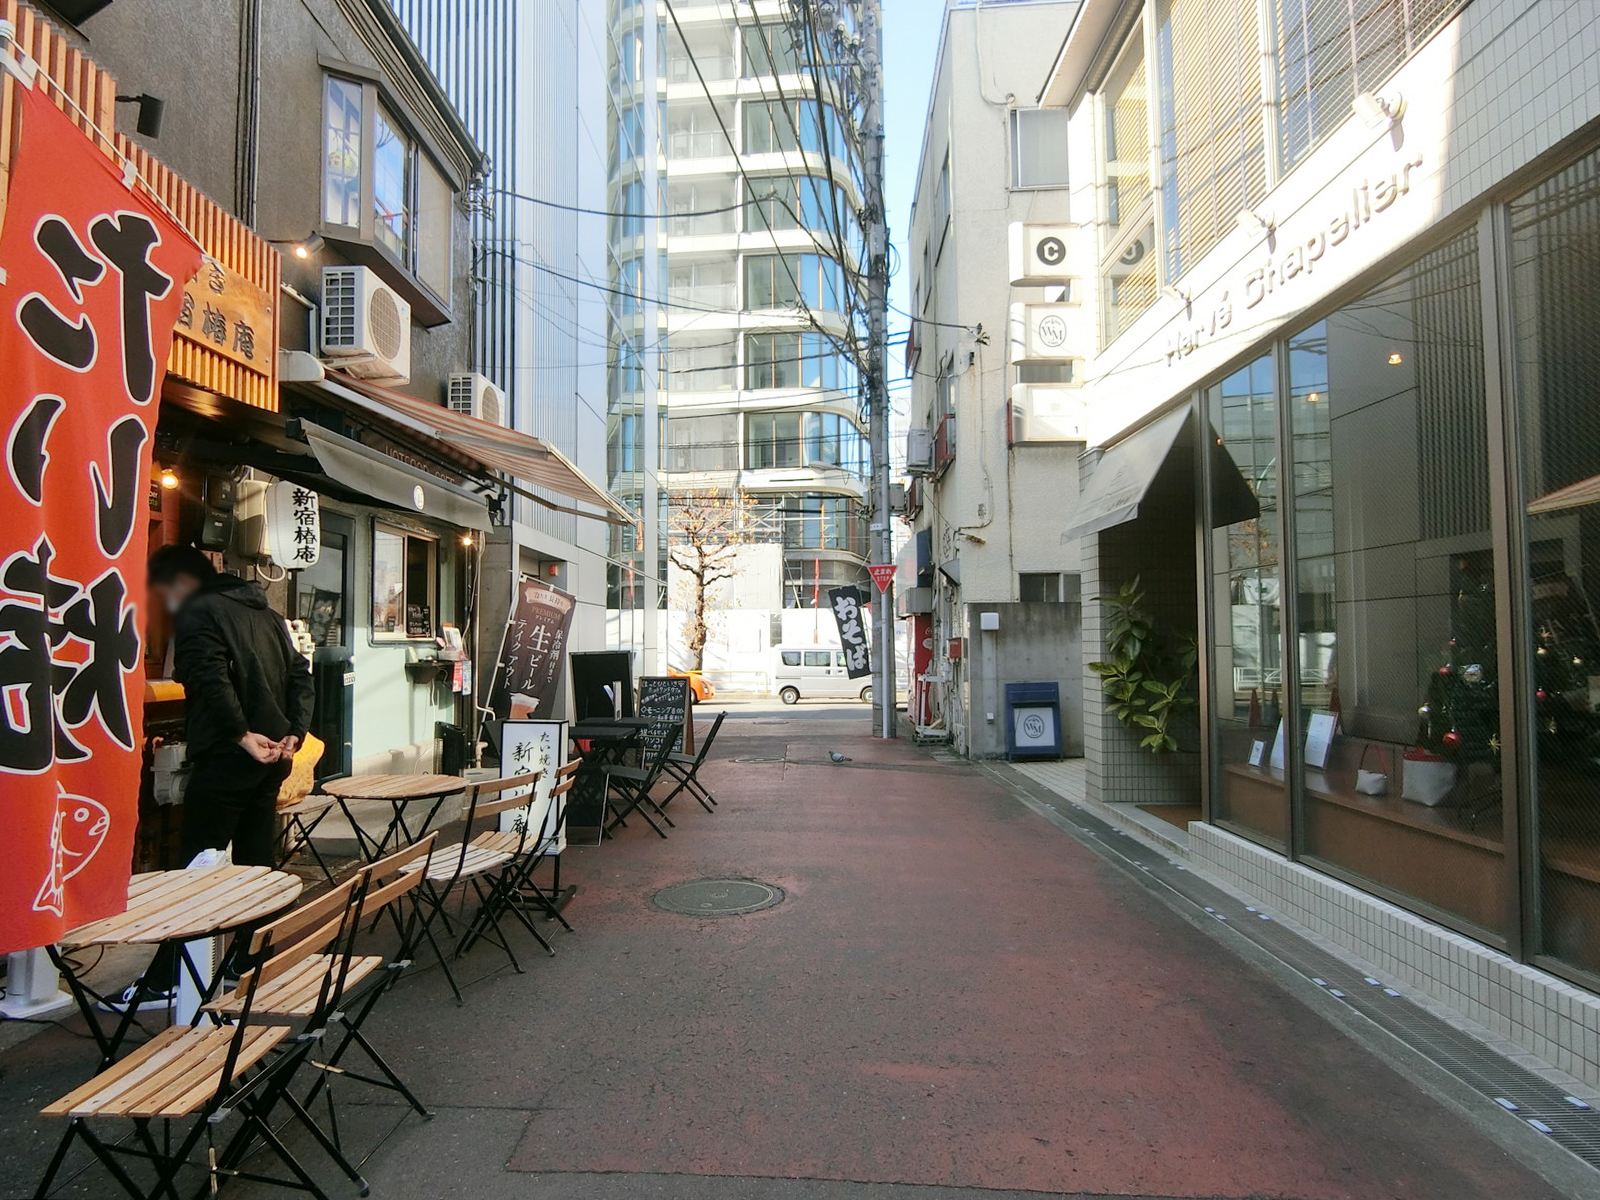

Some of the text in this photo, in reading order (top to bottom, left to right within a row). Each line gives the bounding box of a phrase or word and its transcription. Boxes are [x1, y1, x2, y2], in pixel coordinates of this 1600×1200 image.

[291, 488, 319, 564] 新宿椿庵
[873, 568, 892, 576] 止まれ
[834, 596, 868, 671] おそば
[538, 731, 551, 779] たい焼き
